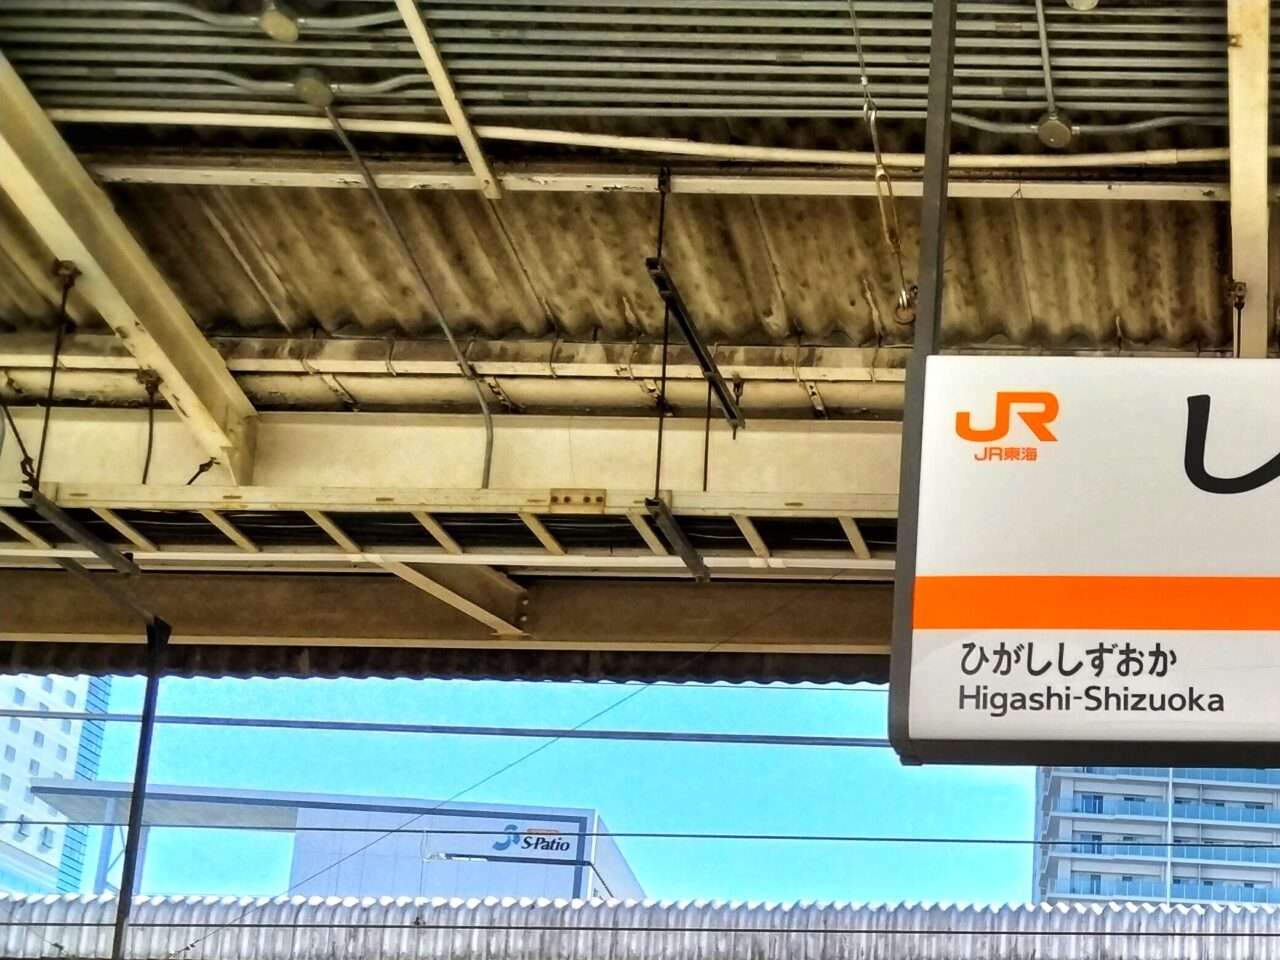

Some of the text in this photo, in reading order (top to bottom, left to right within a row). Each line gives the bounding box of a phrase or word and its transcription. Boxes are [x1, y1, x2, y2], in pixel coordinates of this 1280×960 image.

[955, 391, 1060, 442] JR
[974, 446, 1038, 462] JR東海
[960, 642, 1177, 677] ひがししずおか
[958, 685, 1225, 718] Higashi-Shizuoka
[521, 836, 570, 852] S-Patio
